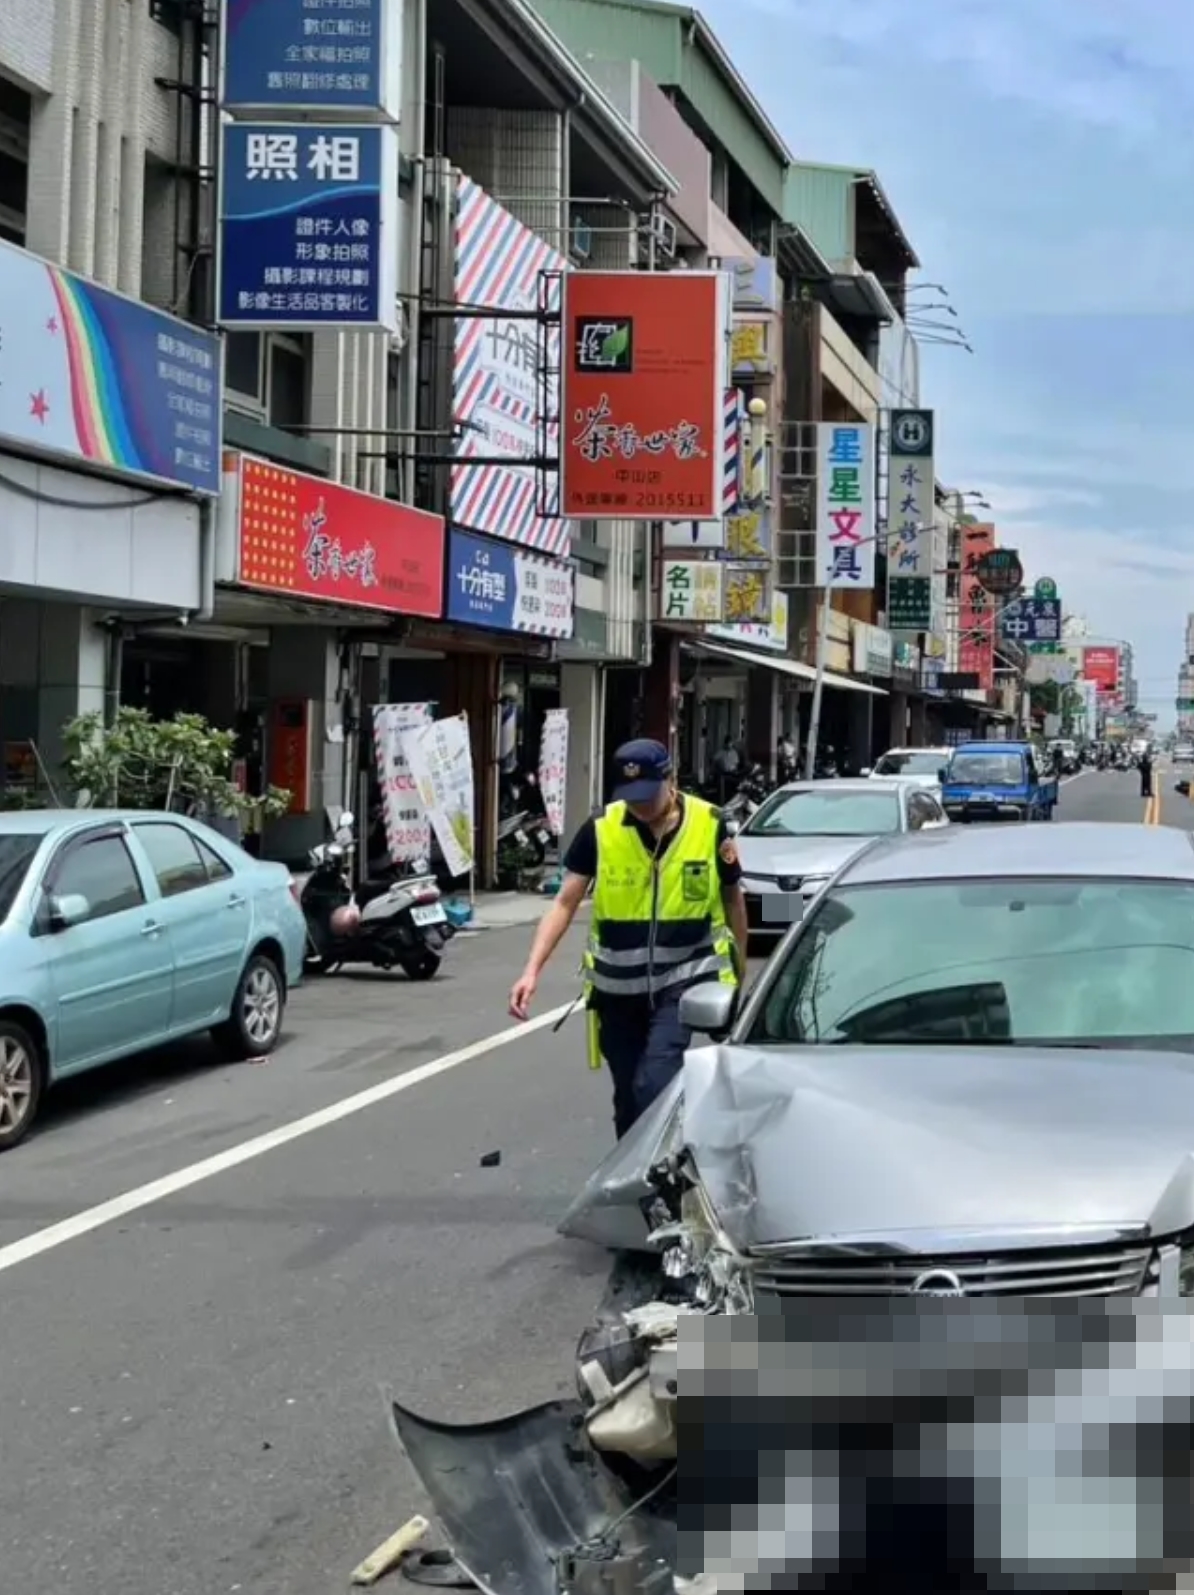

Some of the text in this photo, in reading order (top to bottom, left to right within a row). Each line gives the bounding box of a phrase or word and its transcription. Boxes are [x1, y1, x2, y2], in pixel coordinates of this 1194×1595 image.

[304, 18, 371, 36] 數位輸出
[284, 45, 371, 63] 全家福拍照
[246, 134, 359, 180] 照相
[296, 218, 369, 236] 證件人像
[296, 243, 369, 261] 形象拍照
[265, 267, 369, 286] 攝影課程規劃
[238, 291, 369, 312] 影像生活品客製化
[827, 427, 863, 581] 星星文具
[667, 565, 691, 616] 名片
